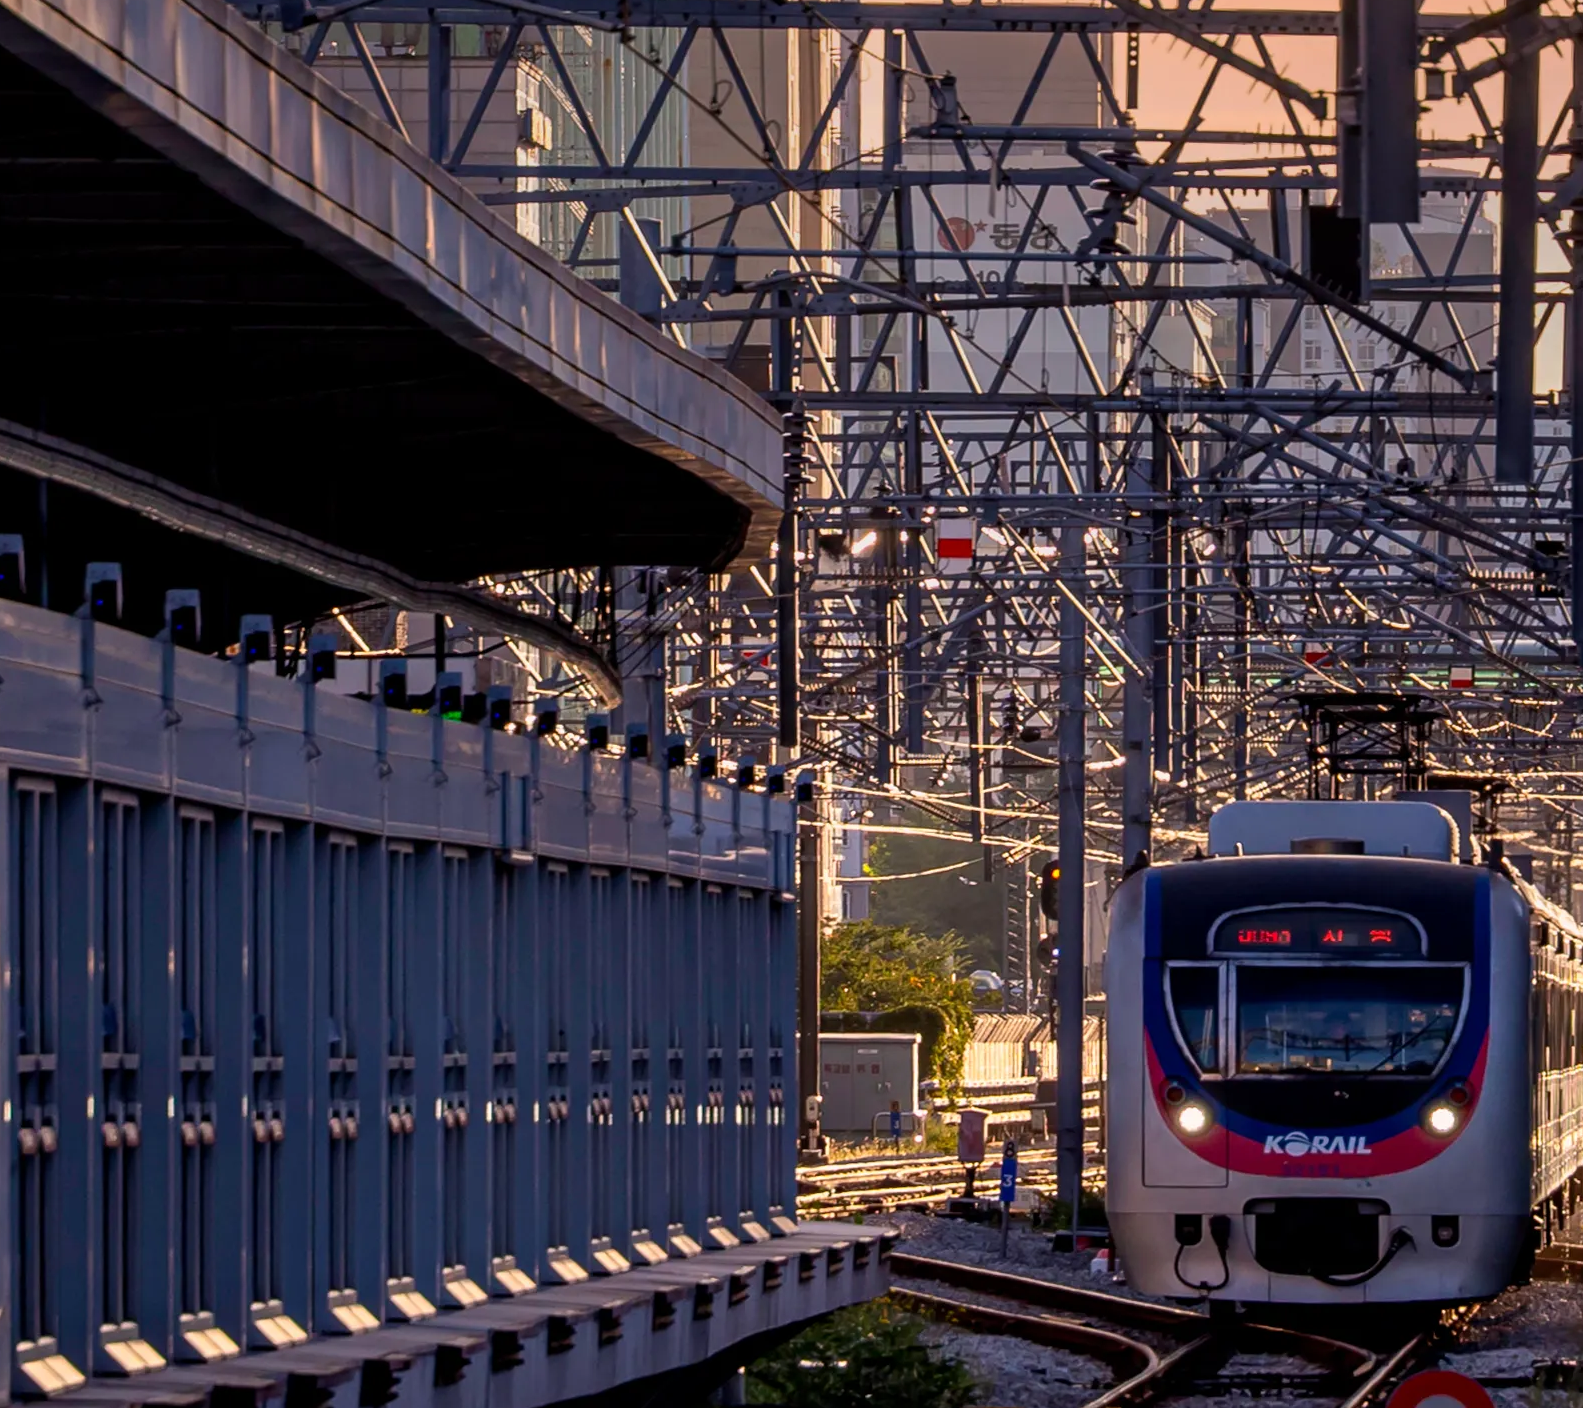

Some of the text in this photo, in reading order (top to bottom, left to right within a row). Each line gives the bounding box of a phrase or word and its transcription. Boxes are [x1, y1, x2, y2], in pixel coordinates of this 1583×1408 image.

[1005, 1141, 1015, 1158] 8
[1263, 1130, 1372, 1157] KORAIL
[1002, 1174, 1014, 1188] 3
